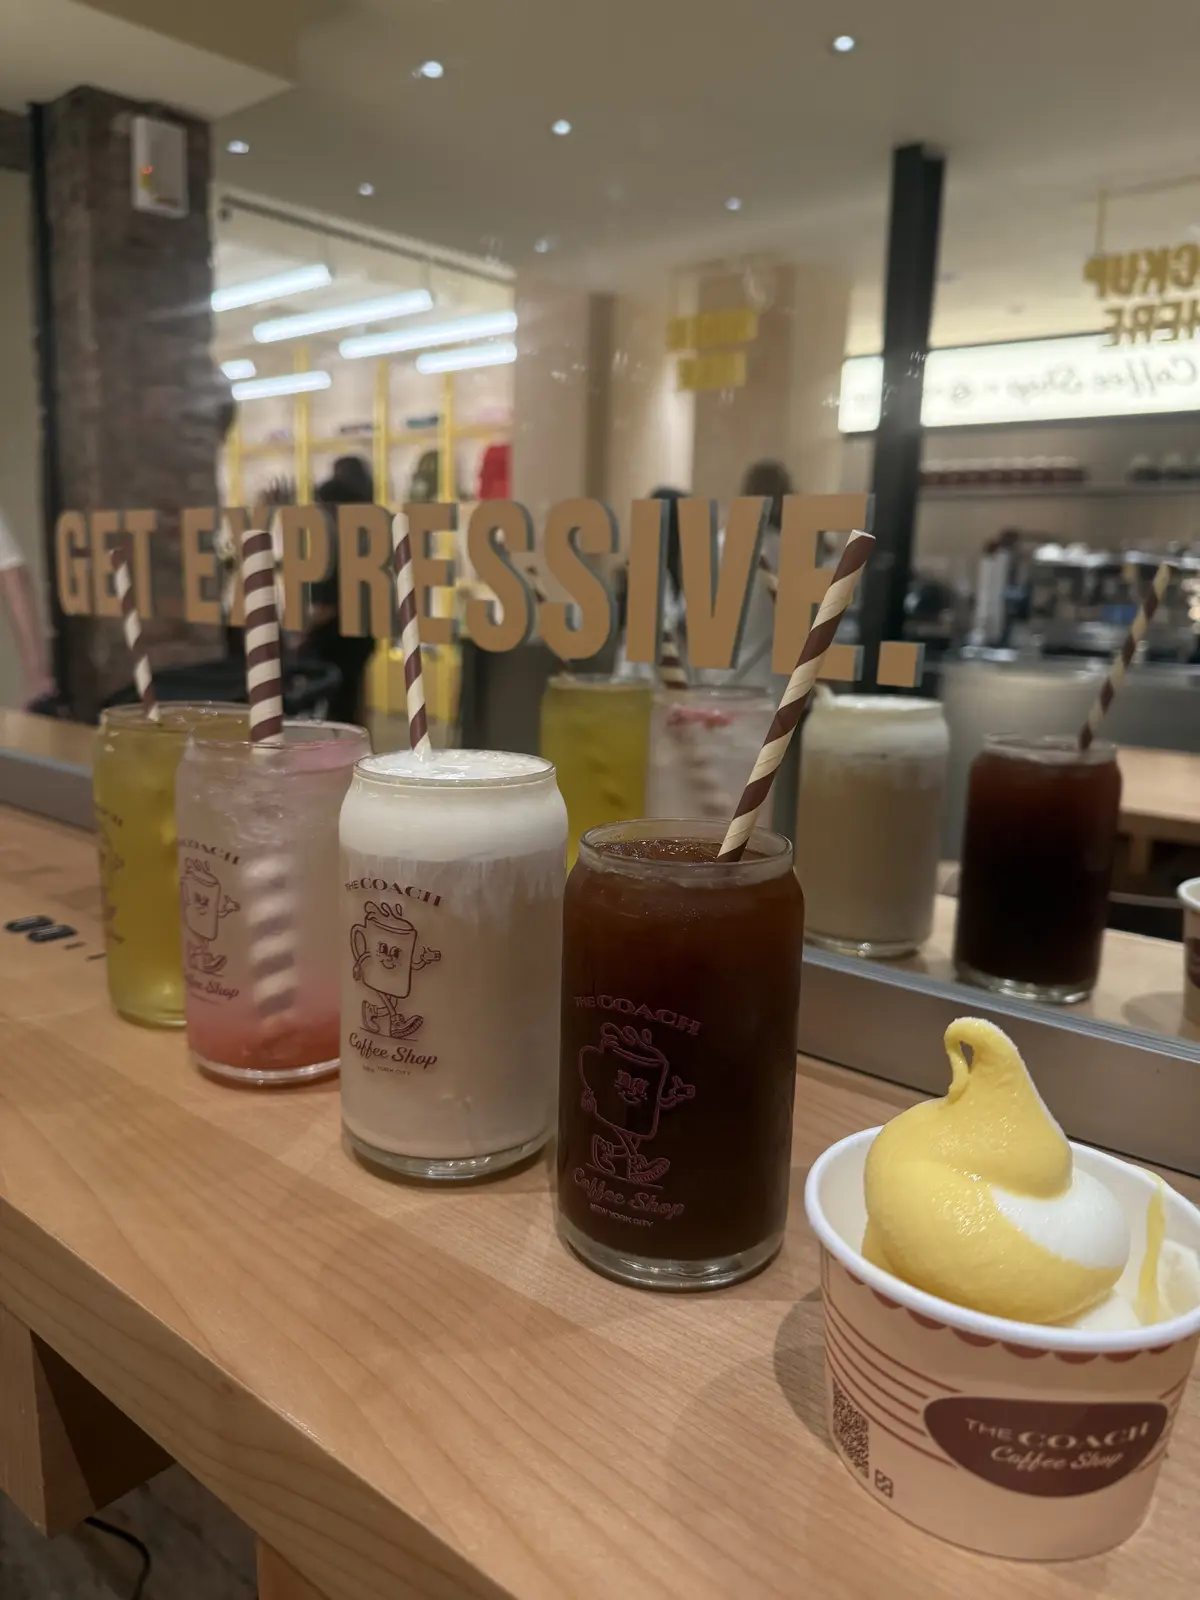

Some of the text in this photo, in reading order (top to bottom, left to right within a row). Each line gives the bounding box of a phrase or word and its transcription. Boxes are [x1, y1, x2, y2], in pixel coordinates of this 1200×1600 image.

[56, 494, 925, 688] GET EXPRESSIVE.
[345, 877, 443, 907] THE COACH
[573, 994, 701, 1036] THE COACH
[349, 1032, 438, 1070] Coffee Shop
[573, 1167, 685, 1220] Coffee Shop
[589, 1202, 654, 1228] NEW YORK CITY
[965, 1417, 1150, 1449] THE COACH
[991, 1446, 1124, 1472] Coffee Shop
